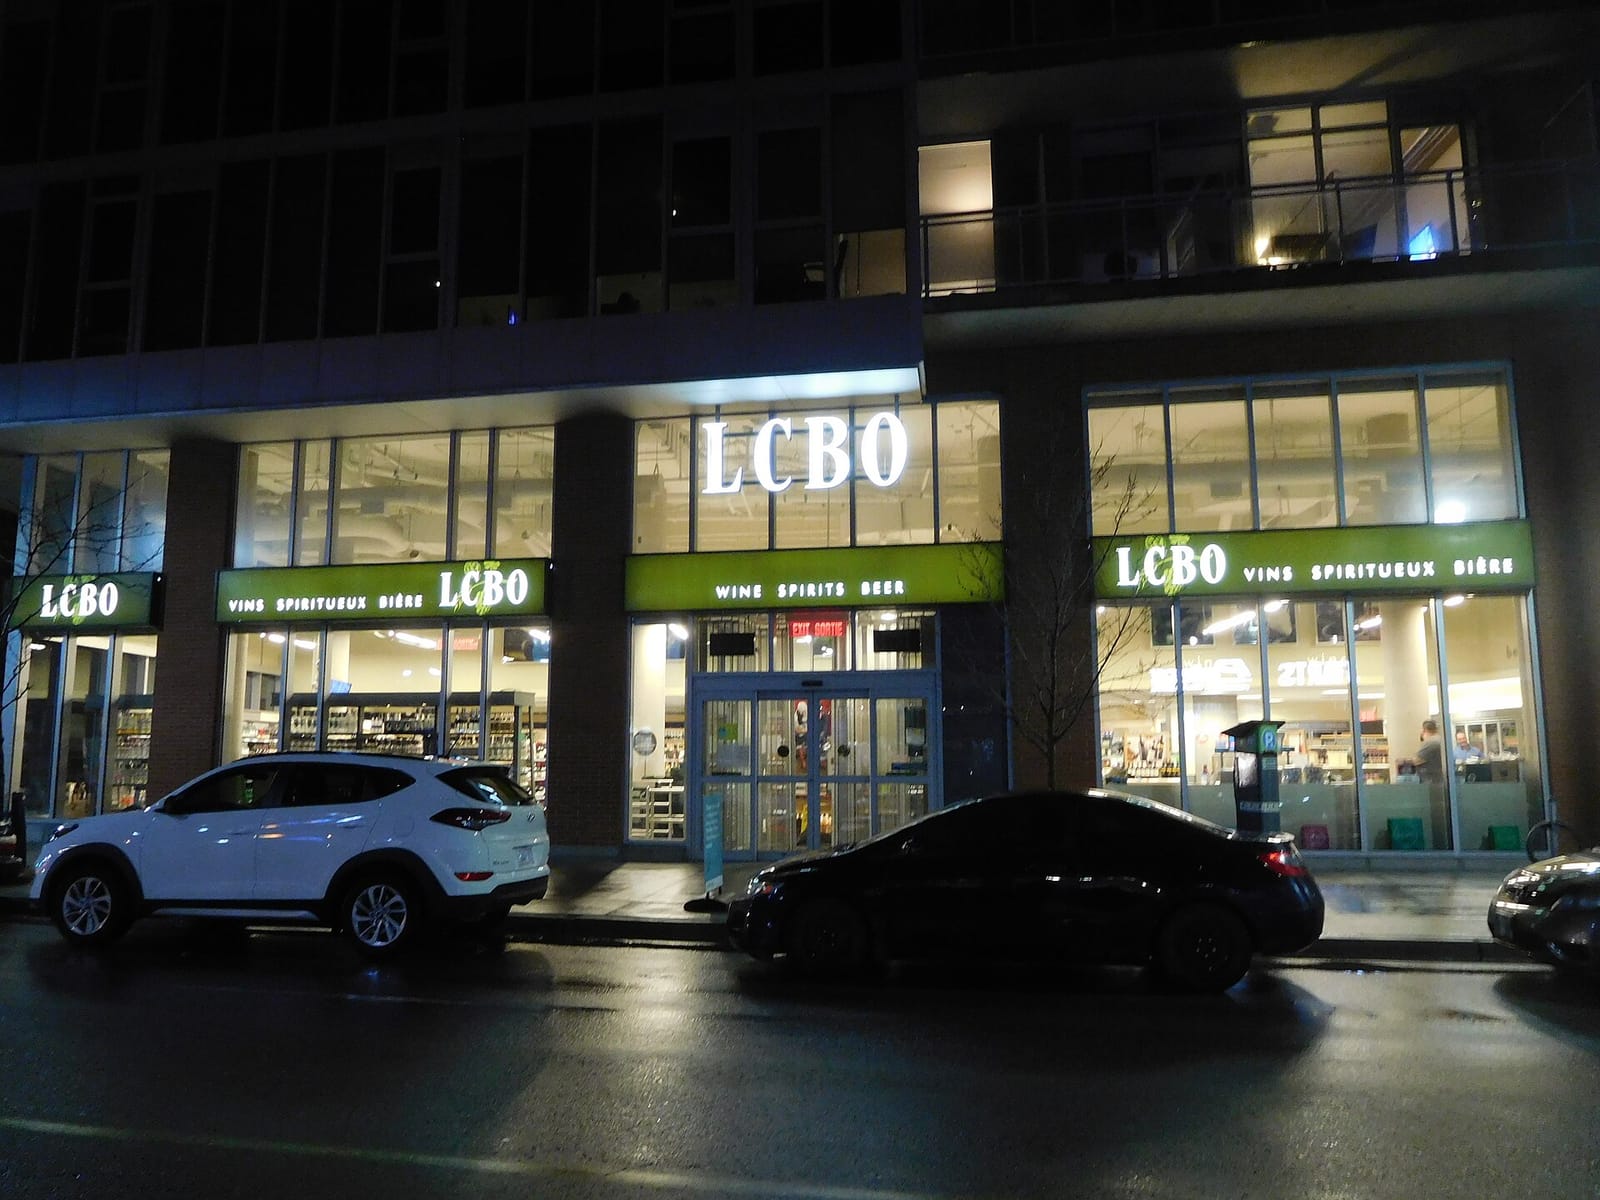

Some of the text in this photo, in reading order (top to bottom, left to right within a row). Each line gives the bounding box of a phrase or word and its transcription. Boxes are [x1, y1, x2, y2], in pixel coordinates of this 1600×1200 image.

[702, 412, 908, 495] LCBO
[1115, 543, 1227, 587] LCBO
[1243, 555, 1514, 582] VINS SPIRITUEUX BIÈRE
[39, 582, 119, 619] LCBO
[228, 592, 423, 613] VINS SPIRITUEUX BIÈRE
[438, 568, 529, 609] LCBO
[715, 580, 905, 599] WINE SPIRITS BEER
[792, 620, 843, 637] EXIT SORTIE
